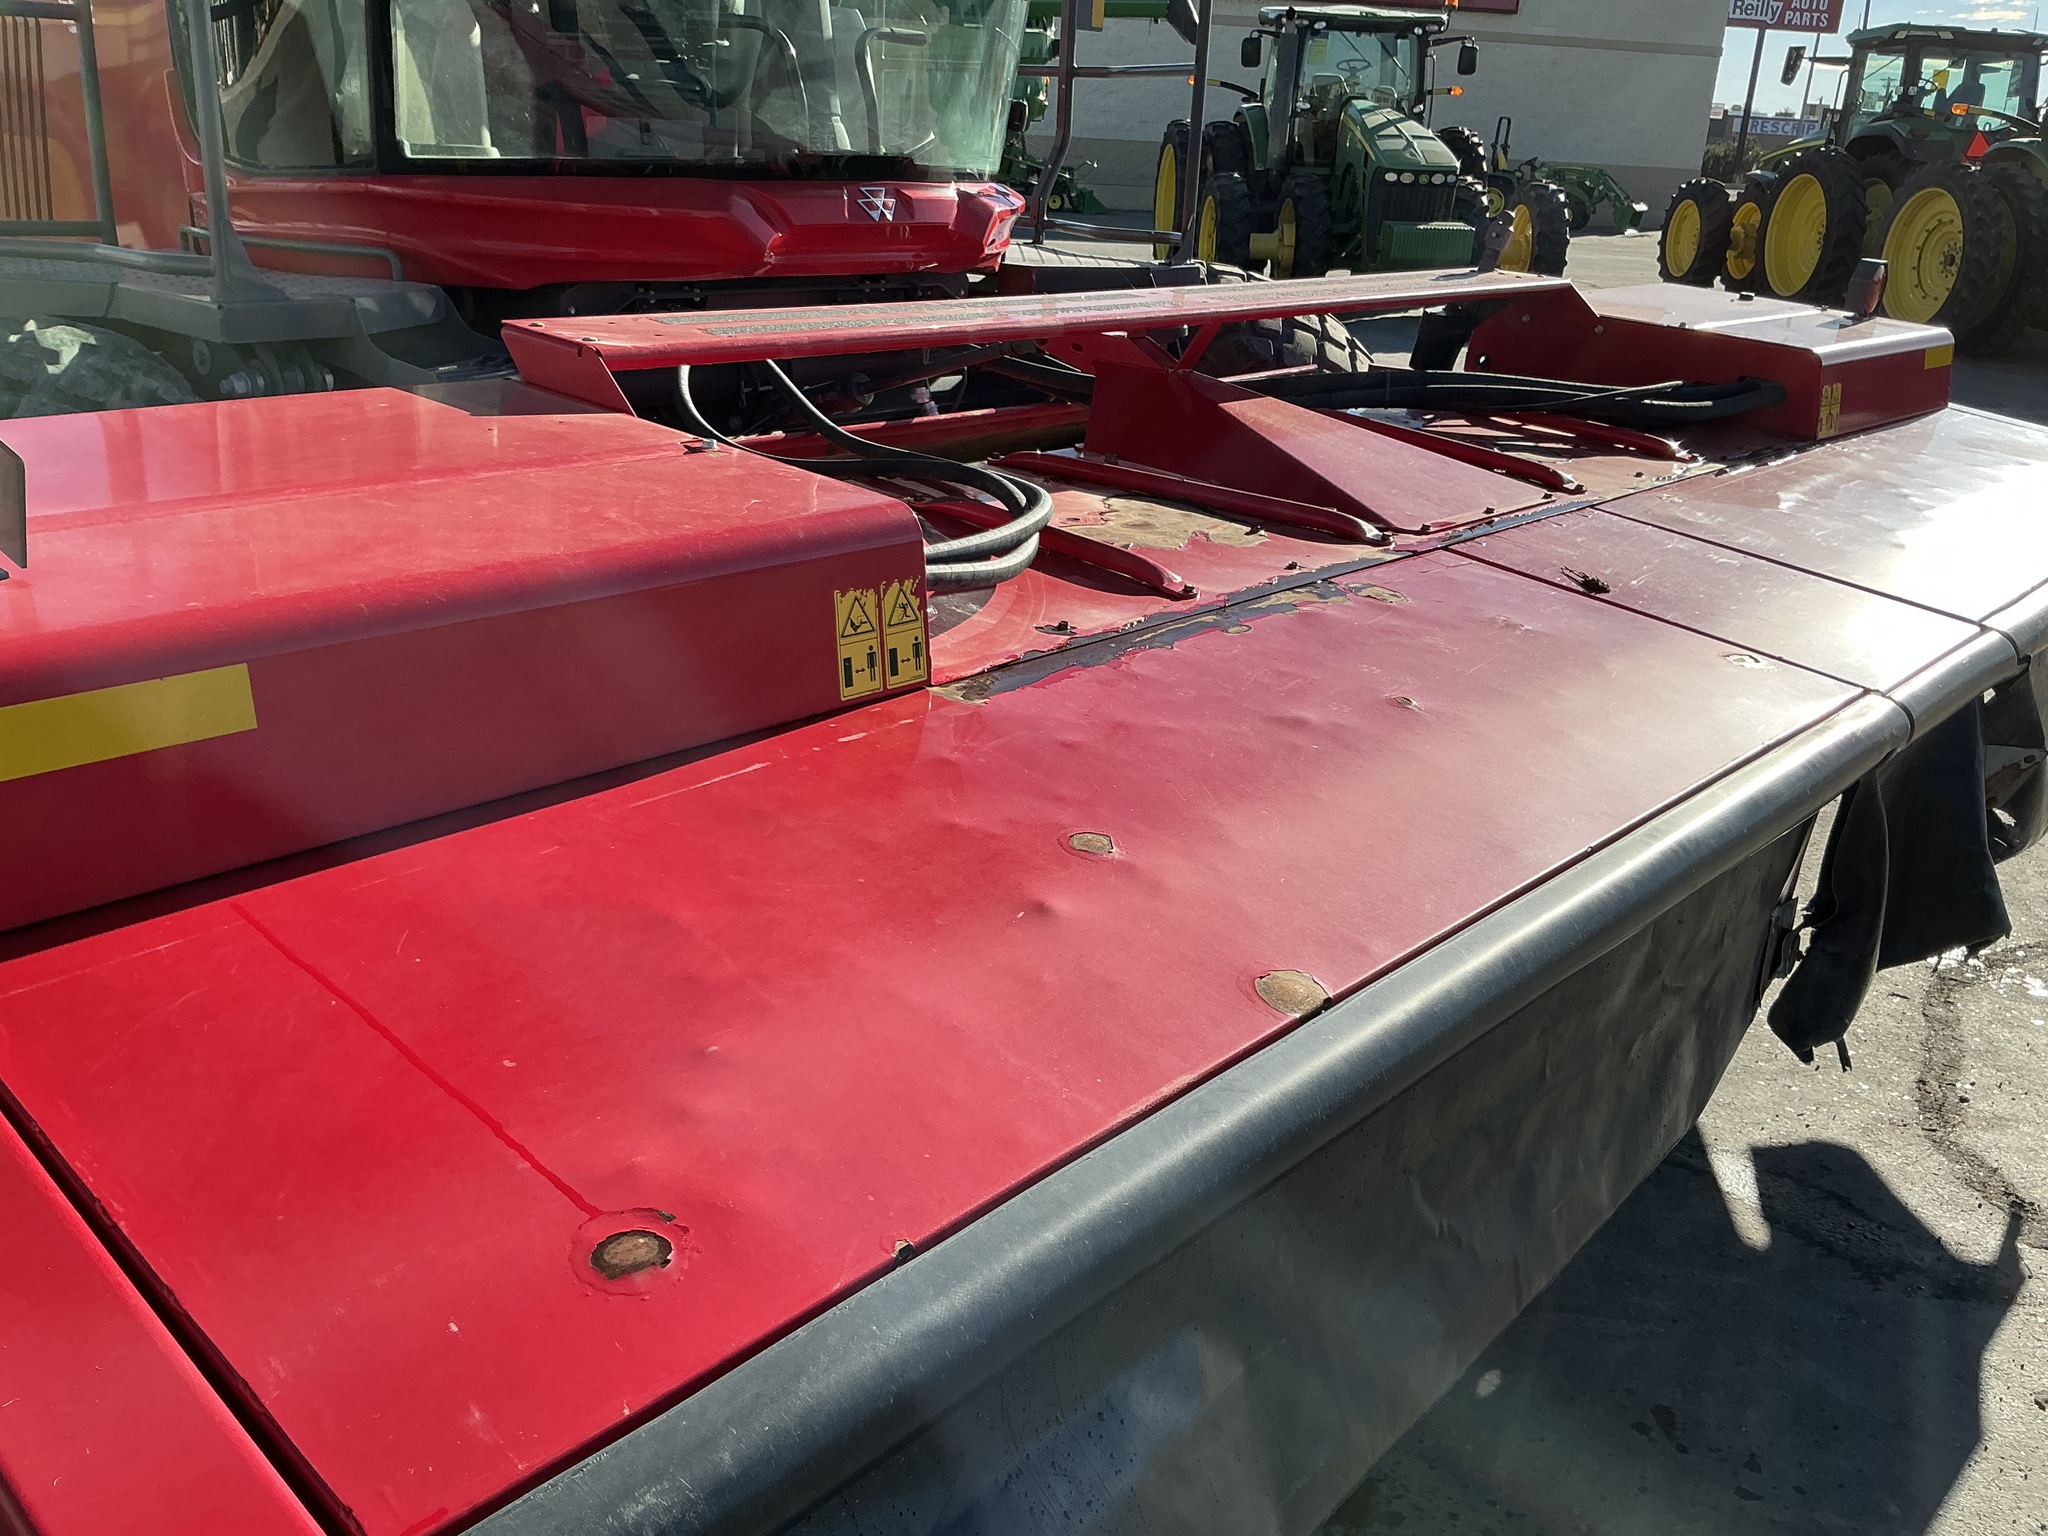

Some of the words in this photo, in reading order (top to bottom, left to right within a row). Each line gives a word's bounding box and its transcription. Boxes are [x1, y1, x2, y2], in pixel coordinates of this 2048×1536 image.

[1791, 0, 1829, 11] AUTO
[1784, 11, 1829, 27] PARTS
[1749, 119, 1816, 135] RESCRIP
